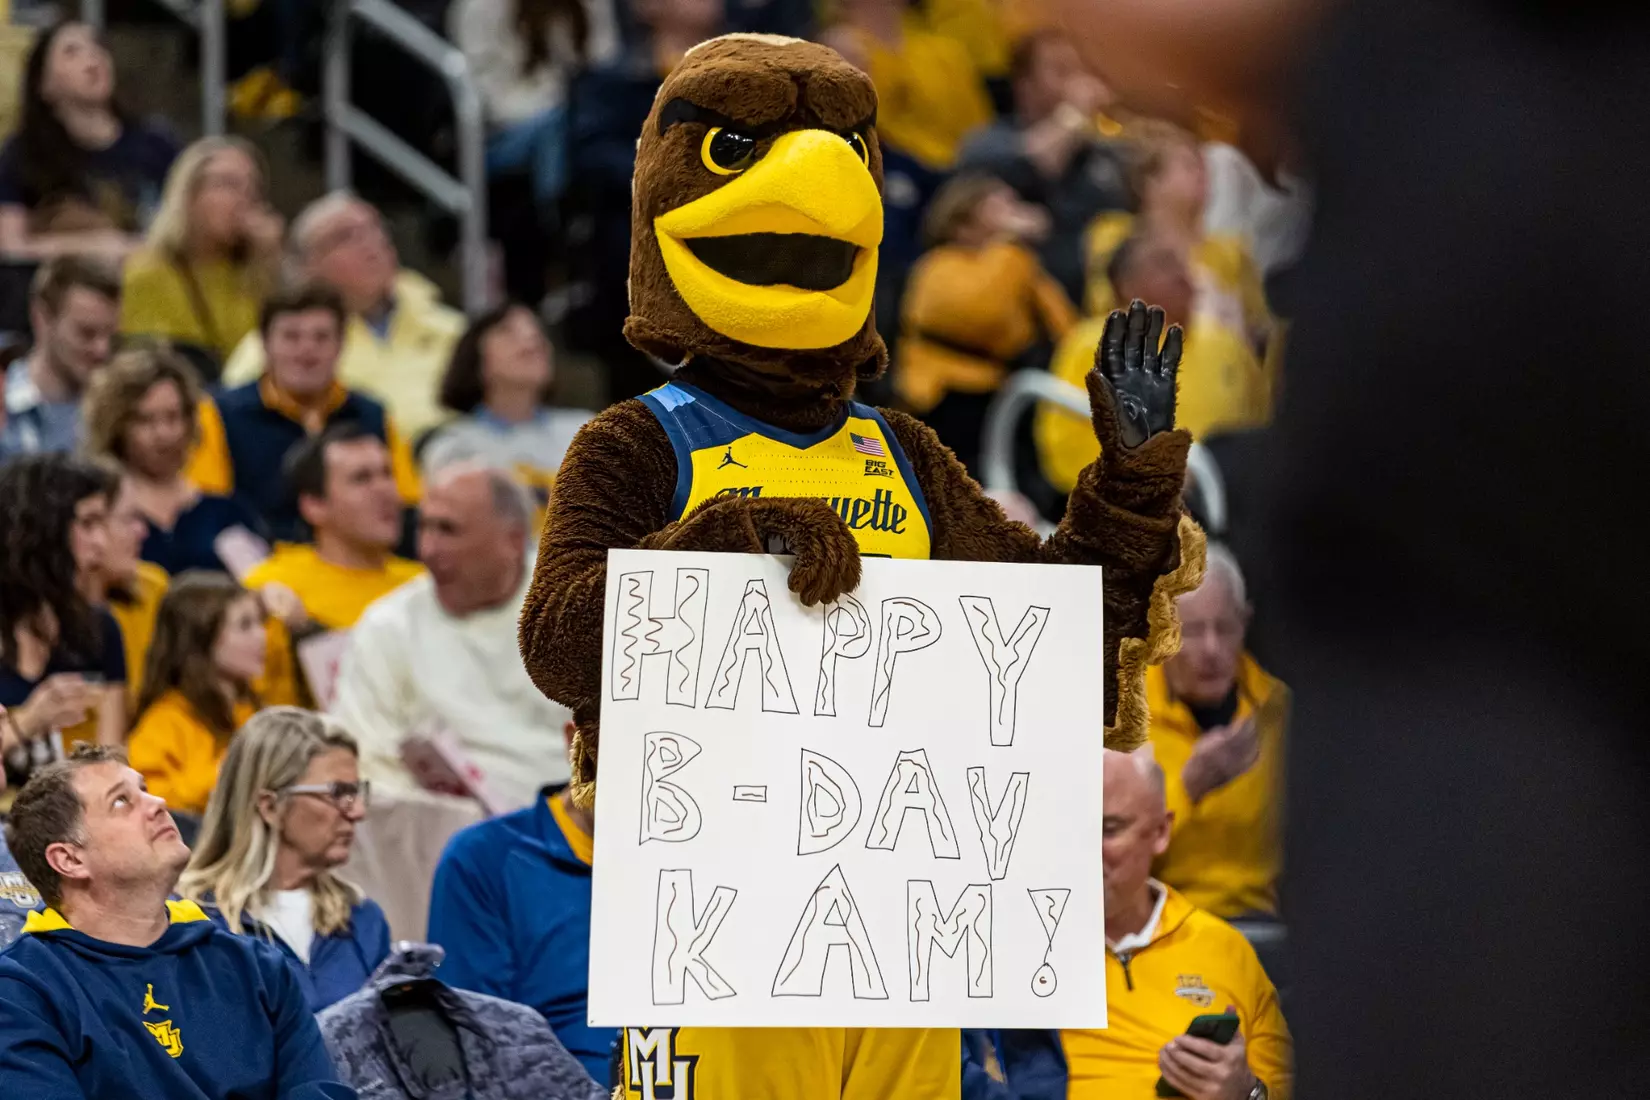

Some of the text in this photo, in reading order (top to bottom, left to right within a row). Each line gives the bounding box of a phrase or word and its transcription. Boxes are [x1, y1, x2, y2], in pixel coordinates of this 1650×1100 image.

[865, 459, 886, 468] BIG
[865, 467, 894, 477] EAST
[611, 567, 1051, 747] HAPPY
[651, 864, 1071, 1005] KAM!
